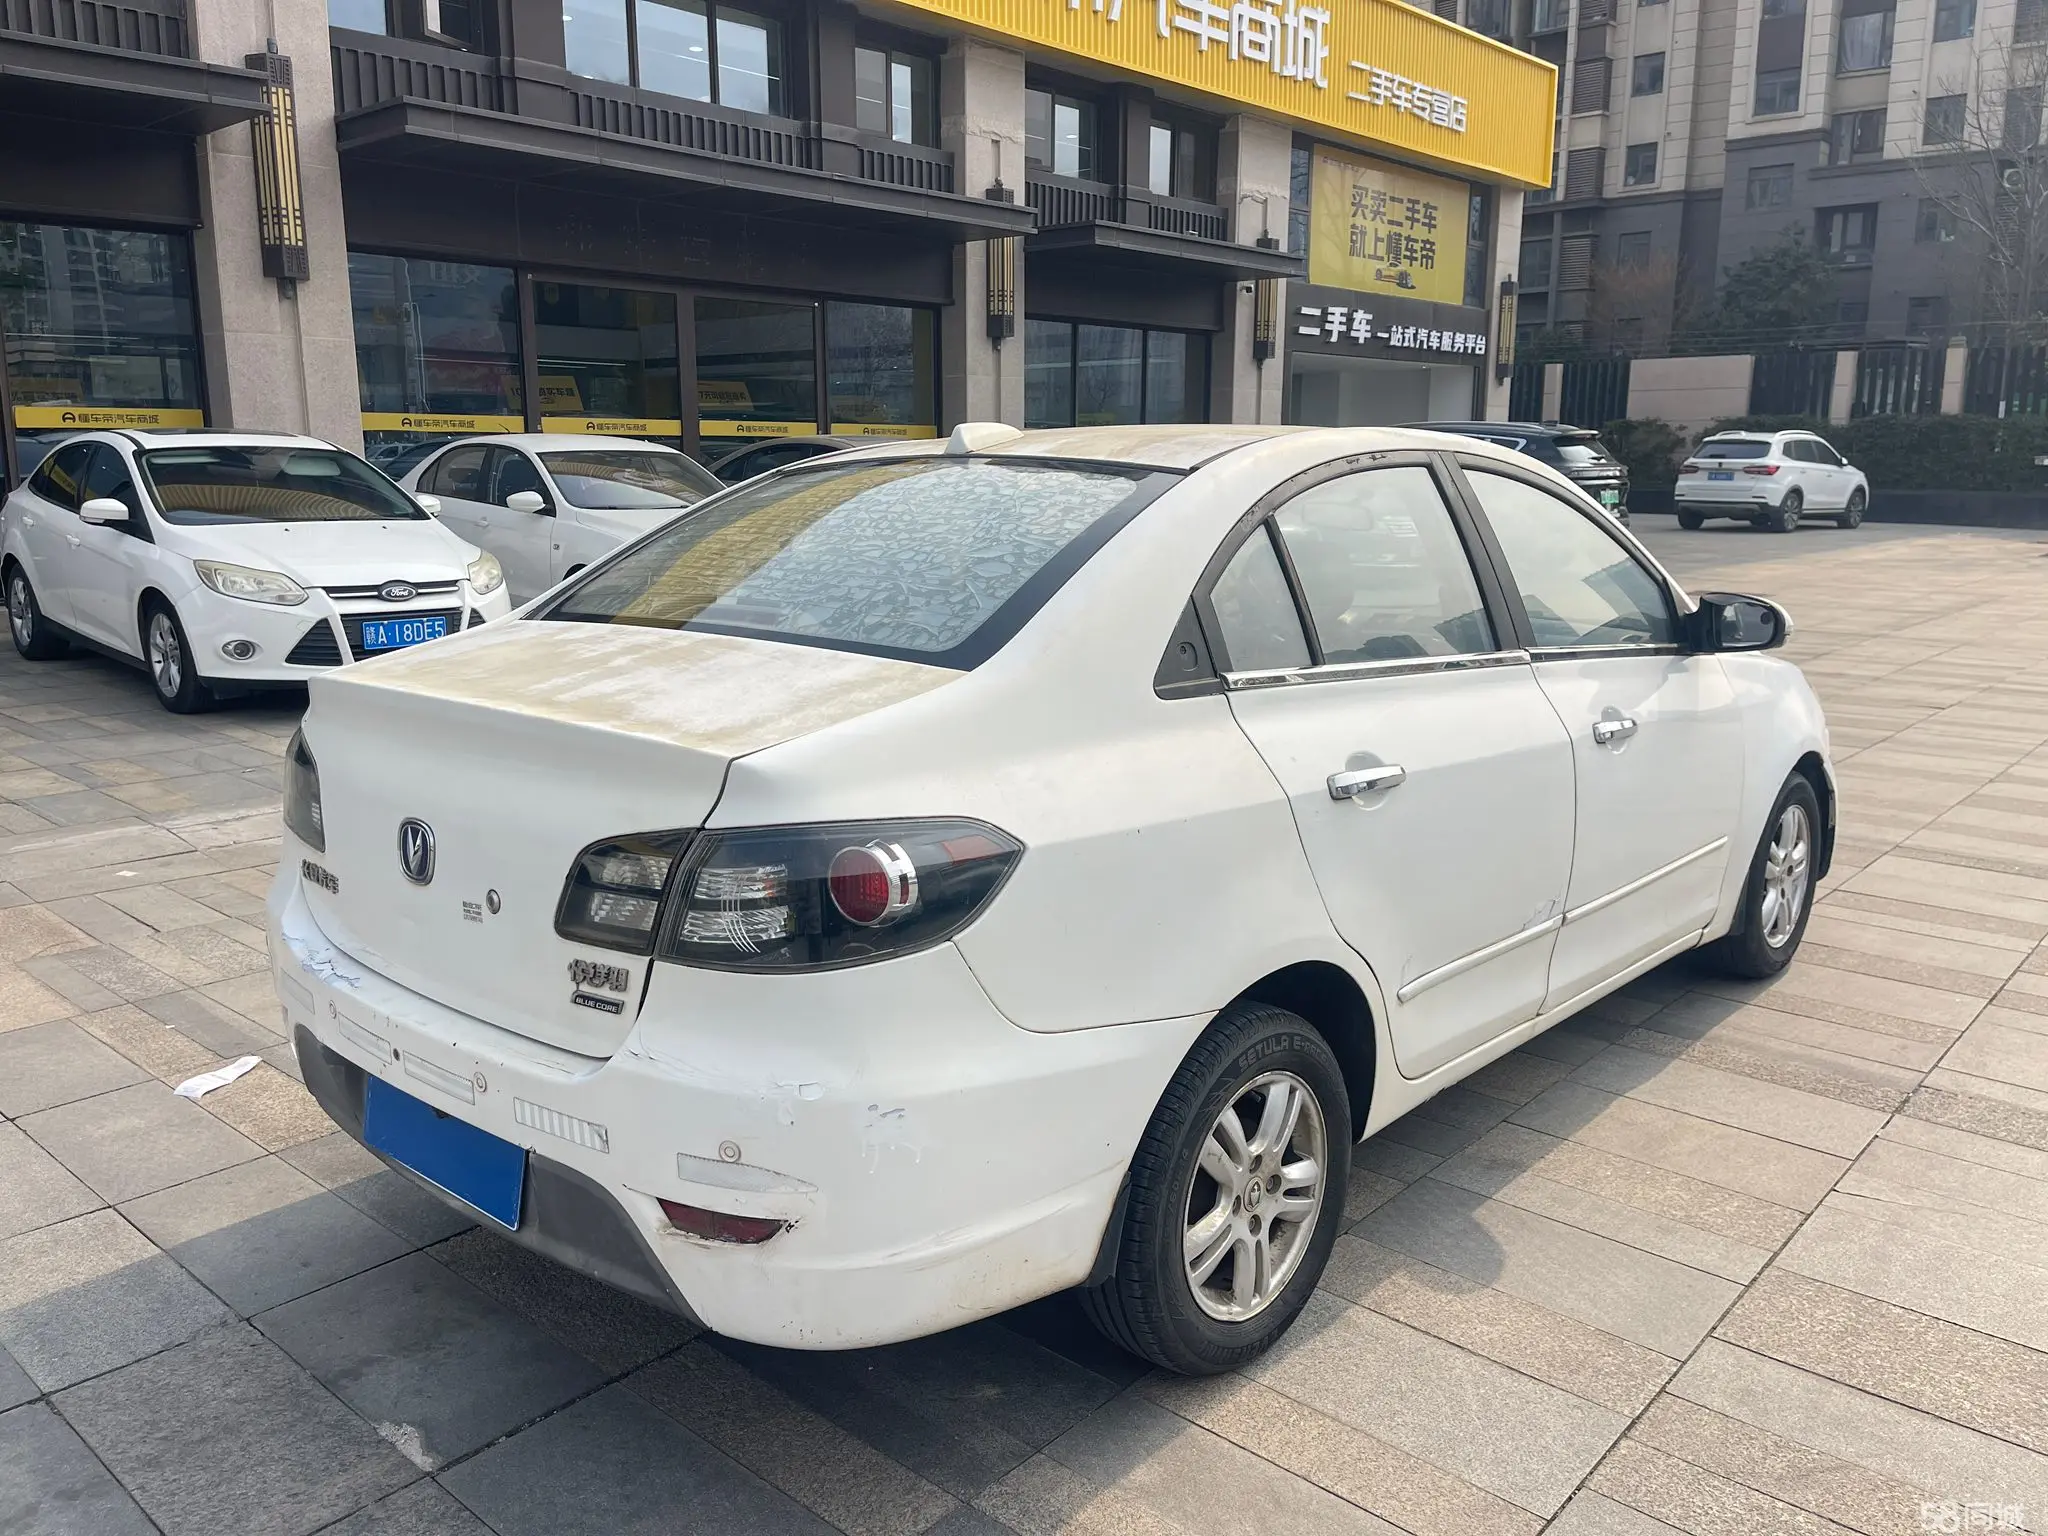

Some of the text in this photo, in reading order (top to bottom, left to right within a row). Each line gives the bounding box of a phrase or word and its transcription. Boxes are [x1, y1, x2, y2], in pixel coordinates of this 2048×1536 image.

[1347, 60, 1468, 133] 二手车专营店
[1351, 184, 1438, 234] 买卖二手车
[1349, 223, 1436, 269] 就上懂车帝
[1297, 306, 1486, 355] 二手车 一站式汽车服务平台
[78, 413, 160, 425] 懂车帝汽车商城
[413, 418, 475, 429] 懂车帝汽车商城
[390, 585, 409, 597] Ford
[575, 996, 619, 1013] BLUE CORE
[1239, 1034, 1289, 1074] SETULA
